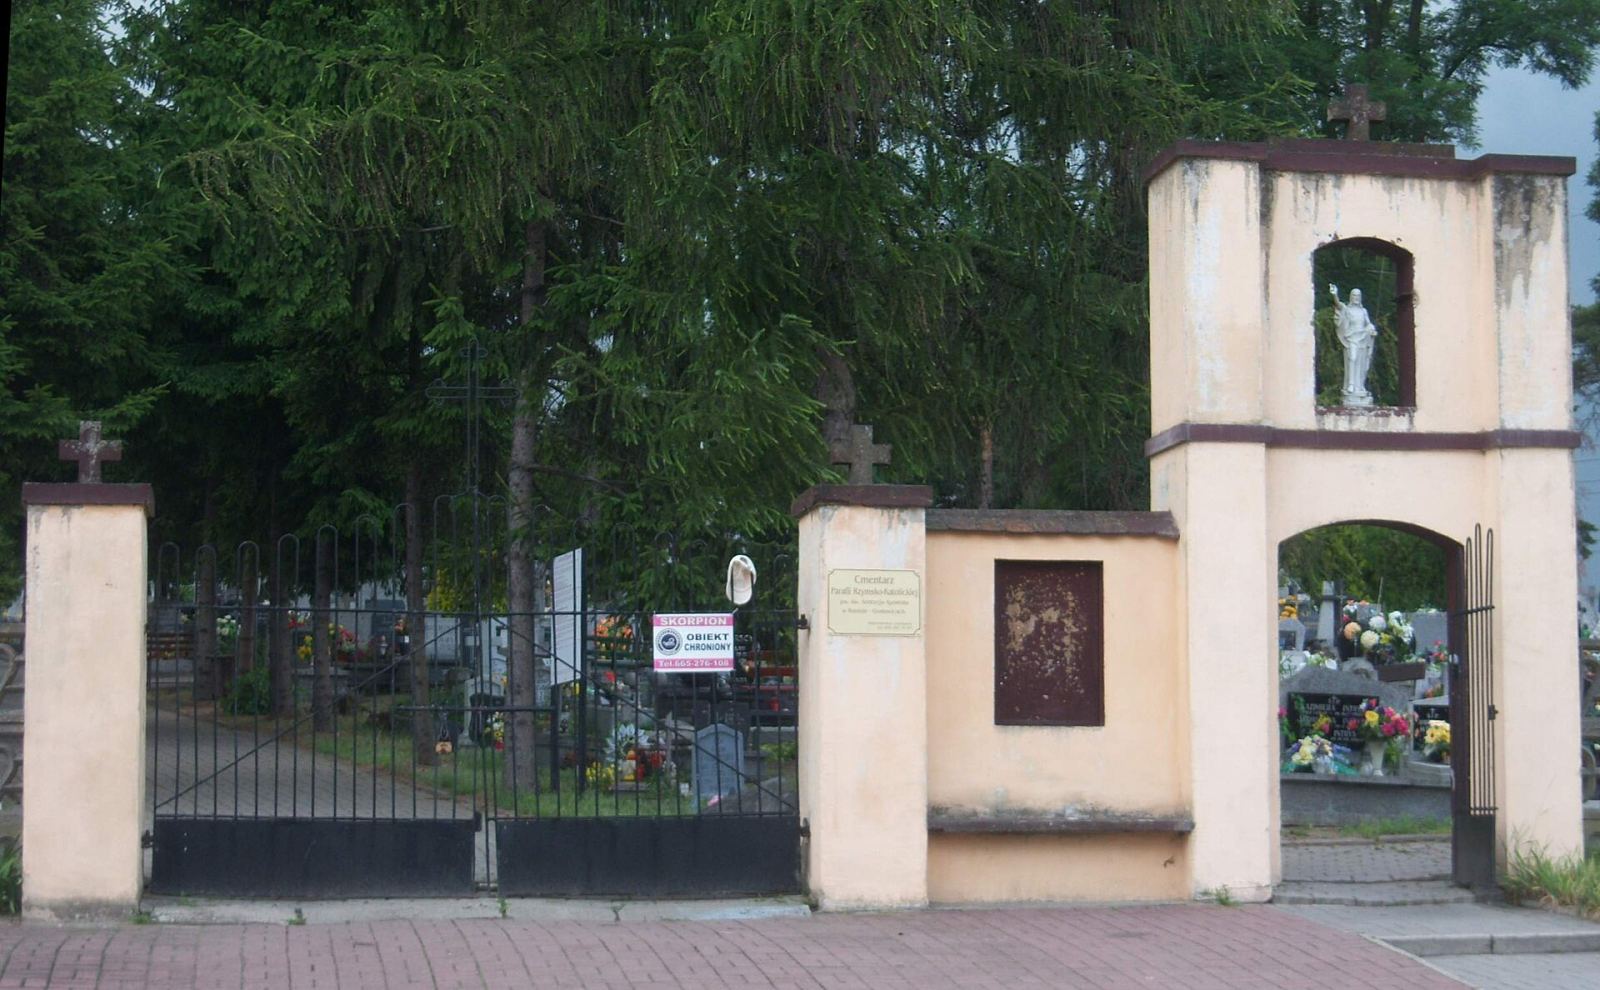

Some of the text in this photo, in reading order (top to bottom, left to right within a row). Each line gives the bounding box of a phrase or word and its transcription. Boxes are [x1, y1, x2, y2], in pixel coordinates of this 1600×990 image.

[854, 574, 895, 585] Cmentarz
[660, 616, 727, 626] SKORPION
[686, 633, 729, 641] OBIEKT
[684, 643, 731, 651] CHRONIONY
